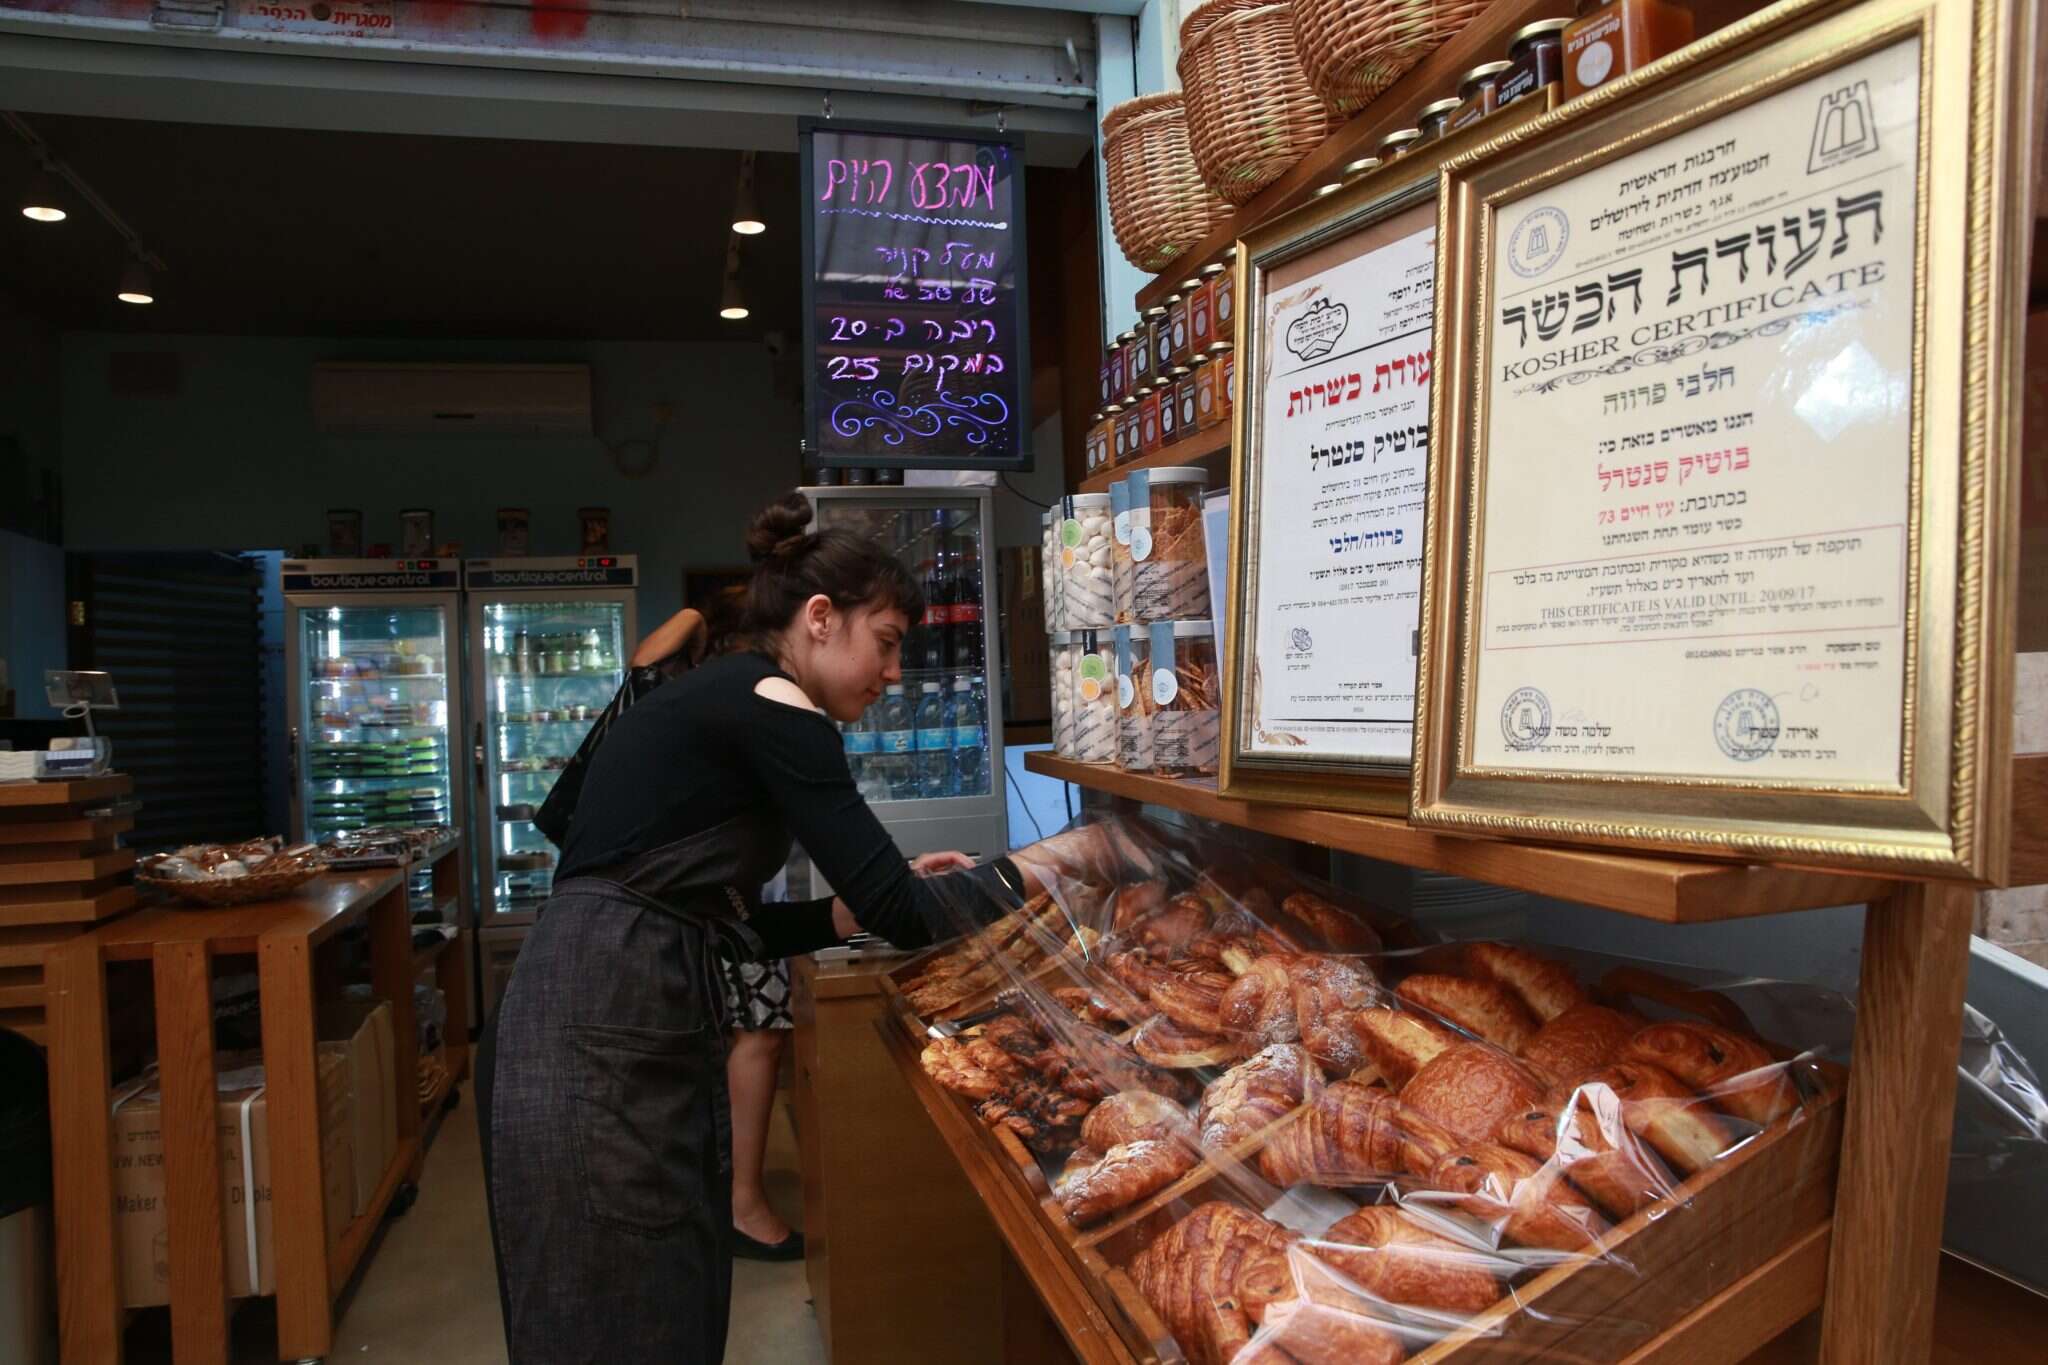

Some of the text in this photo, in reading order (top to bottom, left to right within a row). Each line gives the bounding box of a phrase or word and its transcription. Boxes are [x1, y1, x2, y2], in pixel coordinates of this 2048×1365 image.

[1618, 139, 1736, 197] הרבנות הראשית
[1709, 153, 1770, 189] המועצה
[821, 159, 996, 210] מבצע היום
[1656, 178, 1702, 209] הדתית
[1590, 194, 1650, 232] לירושלים
[1709, 193, 1734, 210] אגף
[1660, 204, 1702, 227] כשרות
[1667, 190, 1884, 307] תעודת
[1502, 267, 1643, 348] הכשר
[922, 319, 997, 344] ריבה
[1502, 261, 1887, 382] KOSHER CERTIFICATE
[826, 352, 1005, 391] במקום 25
[1287, 349, 1433, 418] עודת כשרות
[1603, 362, 1735, 415] חלבי פרווה
[1661, 419, 1718, 443] מאשרים
[1723, 412, 1753, 430] הננו
[1310, 423, 1428, 472] בוטיק סנטרל
[1620, 432, 1654, 451] בזאת
[1598, 446, 1750, 492] בוטיק סנטרל
[1598, 490, 1746, 525] בכתובת: עץ חיים 73
[1652, 526, 1679, 541] תחת
[1682, 522, 1712, 536] עומד
[1716, 517, 1743, 532] כשר
[1329, 529, 1404, 554] פרווה/חלבי
[1747, 545, 1788, 562] תעודה
[1792, 540, 1812, 555] של
[1688, 569, 1729, 591] לתאריך
[1734, 570, 1755, 584] ועד
[1541, 605, 1566, 619] THIS
[1567, 599, 1646, 617] CERTIFICATE
[1648, 598, 1660, 610] IS
[1664, 594, 1706, 609] VALID
[1759, 585, 1816, 603] 20/09/17
[1555, 726, 1578, 738] משה
[1582, 721, 1612, 738] שלמה
[1786, 726, 1819, 740] אריה
